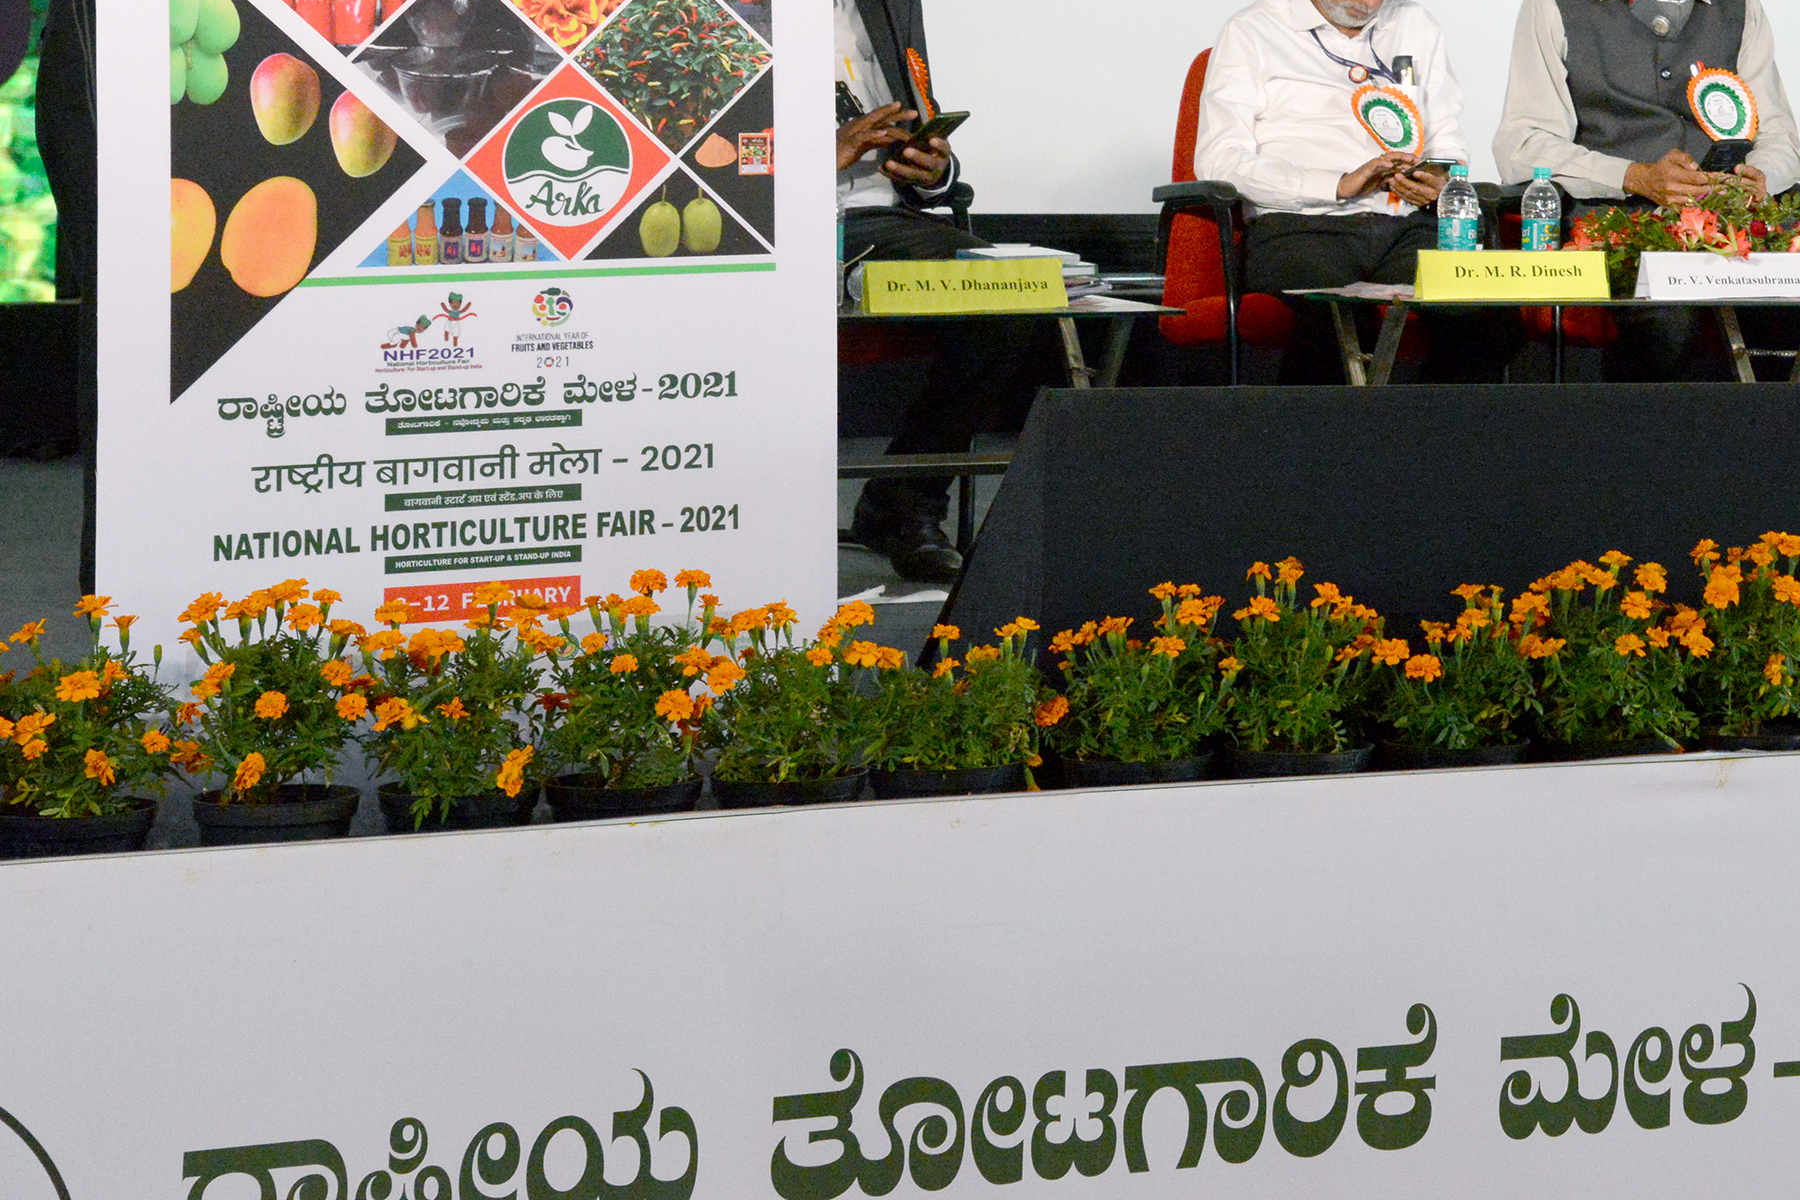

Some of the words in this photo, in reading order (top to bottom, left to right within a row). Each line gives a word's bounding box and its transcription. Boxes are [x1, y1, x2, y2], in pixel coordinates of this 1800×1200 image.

[526, 180, 604, 216] Arka
[1455, 266, 1479, 278] Dr.
[1485, 266, 1504, 277] M.
[1510, 266, 1526, 277] R.
[1532, 265, 1582, 277] Dinesh
[887, 281, 910, 292] Dr.
[916, 280, 935, 291] M.
[940, 280, 956, 291] V.
[961, 279, 1048, 292] Dhananjaya
[1667, 275, 1687, 286] Dr.
[1689, 275, 1703, 286] V.
[384, 347, 473, 361] NHF2021
[512, 343, 535, 352] FRUITS
[536, 343, 550, 351] AND
[552, 341, 593, 350] VEGETABLES
[536, 356, 570, 368] 2021
[218, 386, 347, 438] ರಾಷ್ಟ್ರೀಯ
[365, 376, 546, 413] ತೋಟಗಾರಿಕೆ
[251, 454, 366, 494] राष्ट्रीय
[373, 444, 520, 485] बागवानी
[527, 443, 602, 477] मेला
[641, 443, 713, 471] 2021
[214, 527, 360, 561] NATIONAL
[371, 513, 587, 551] HORTICULTURE
[597, 509, 655, 538] FAIR
[680, 504, 738, 532] 2021
[395, 558, 452, 568] HORTICULTURE
[470, 555, 505, 563] START-UP
[514, 552, 550, 560] STAND-UP
[771, 1003, 1437, 1200] ತೋಟಗಾರಿಕೆ
